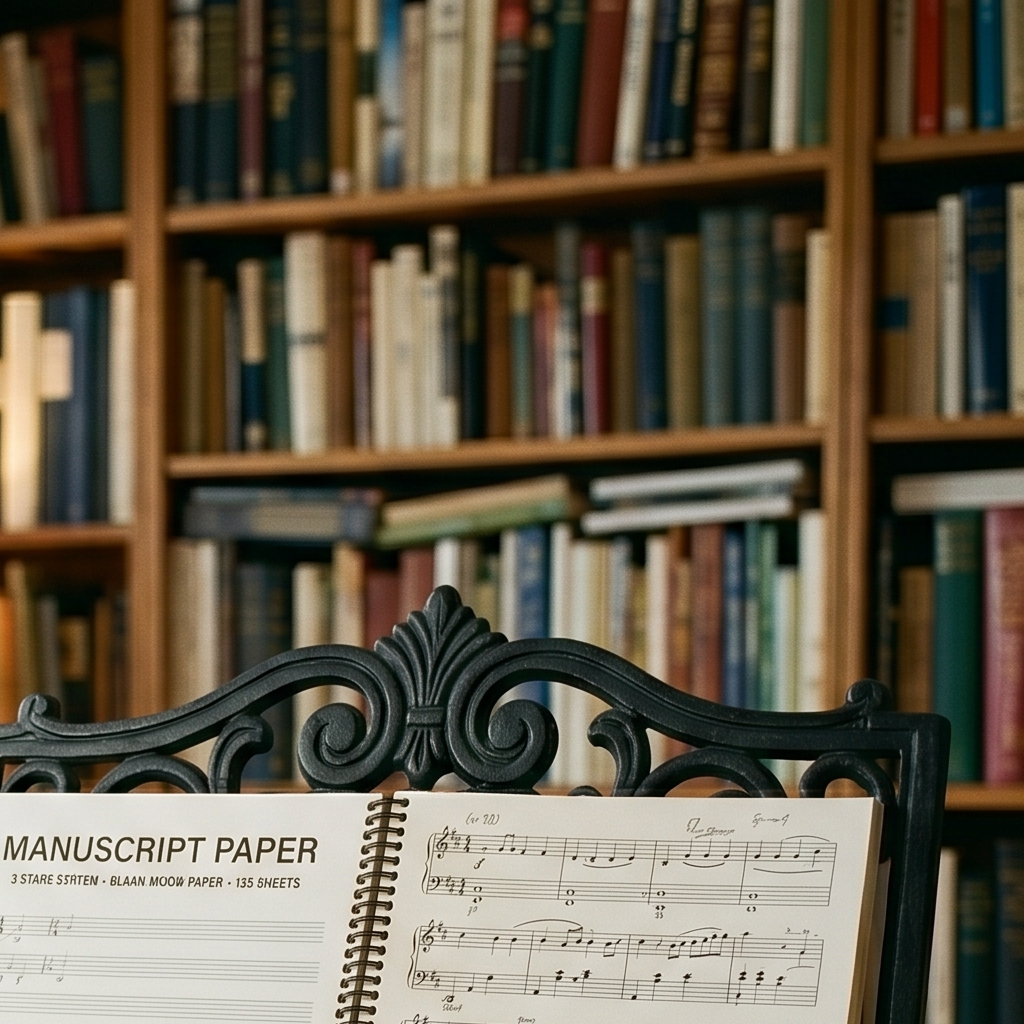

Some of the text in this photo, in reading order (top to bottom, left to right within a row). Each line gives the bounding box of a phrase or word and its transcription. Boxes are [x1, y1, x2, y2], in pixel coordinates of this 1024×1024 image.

[2, 835, 319, 864] MANUSCRIPT PAPER
[10, 873, 18, 885] 3
[187, 876, 224, 888] PAPER
[235, 877, 254, 889] 135
